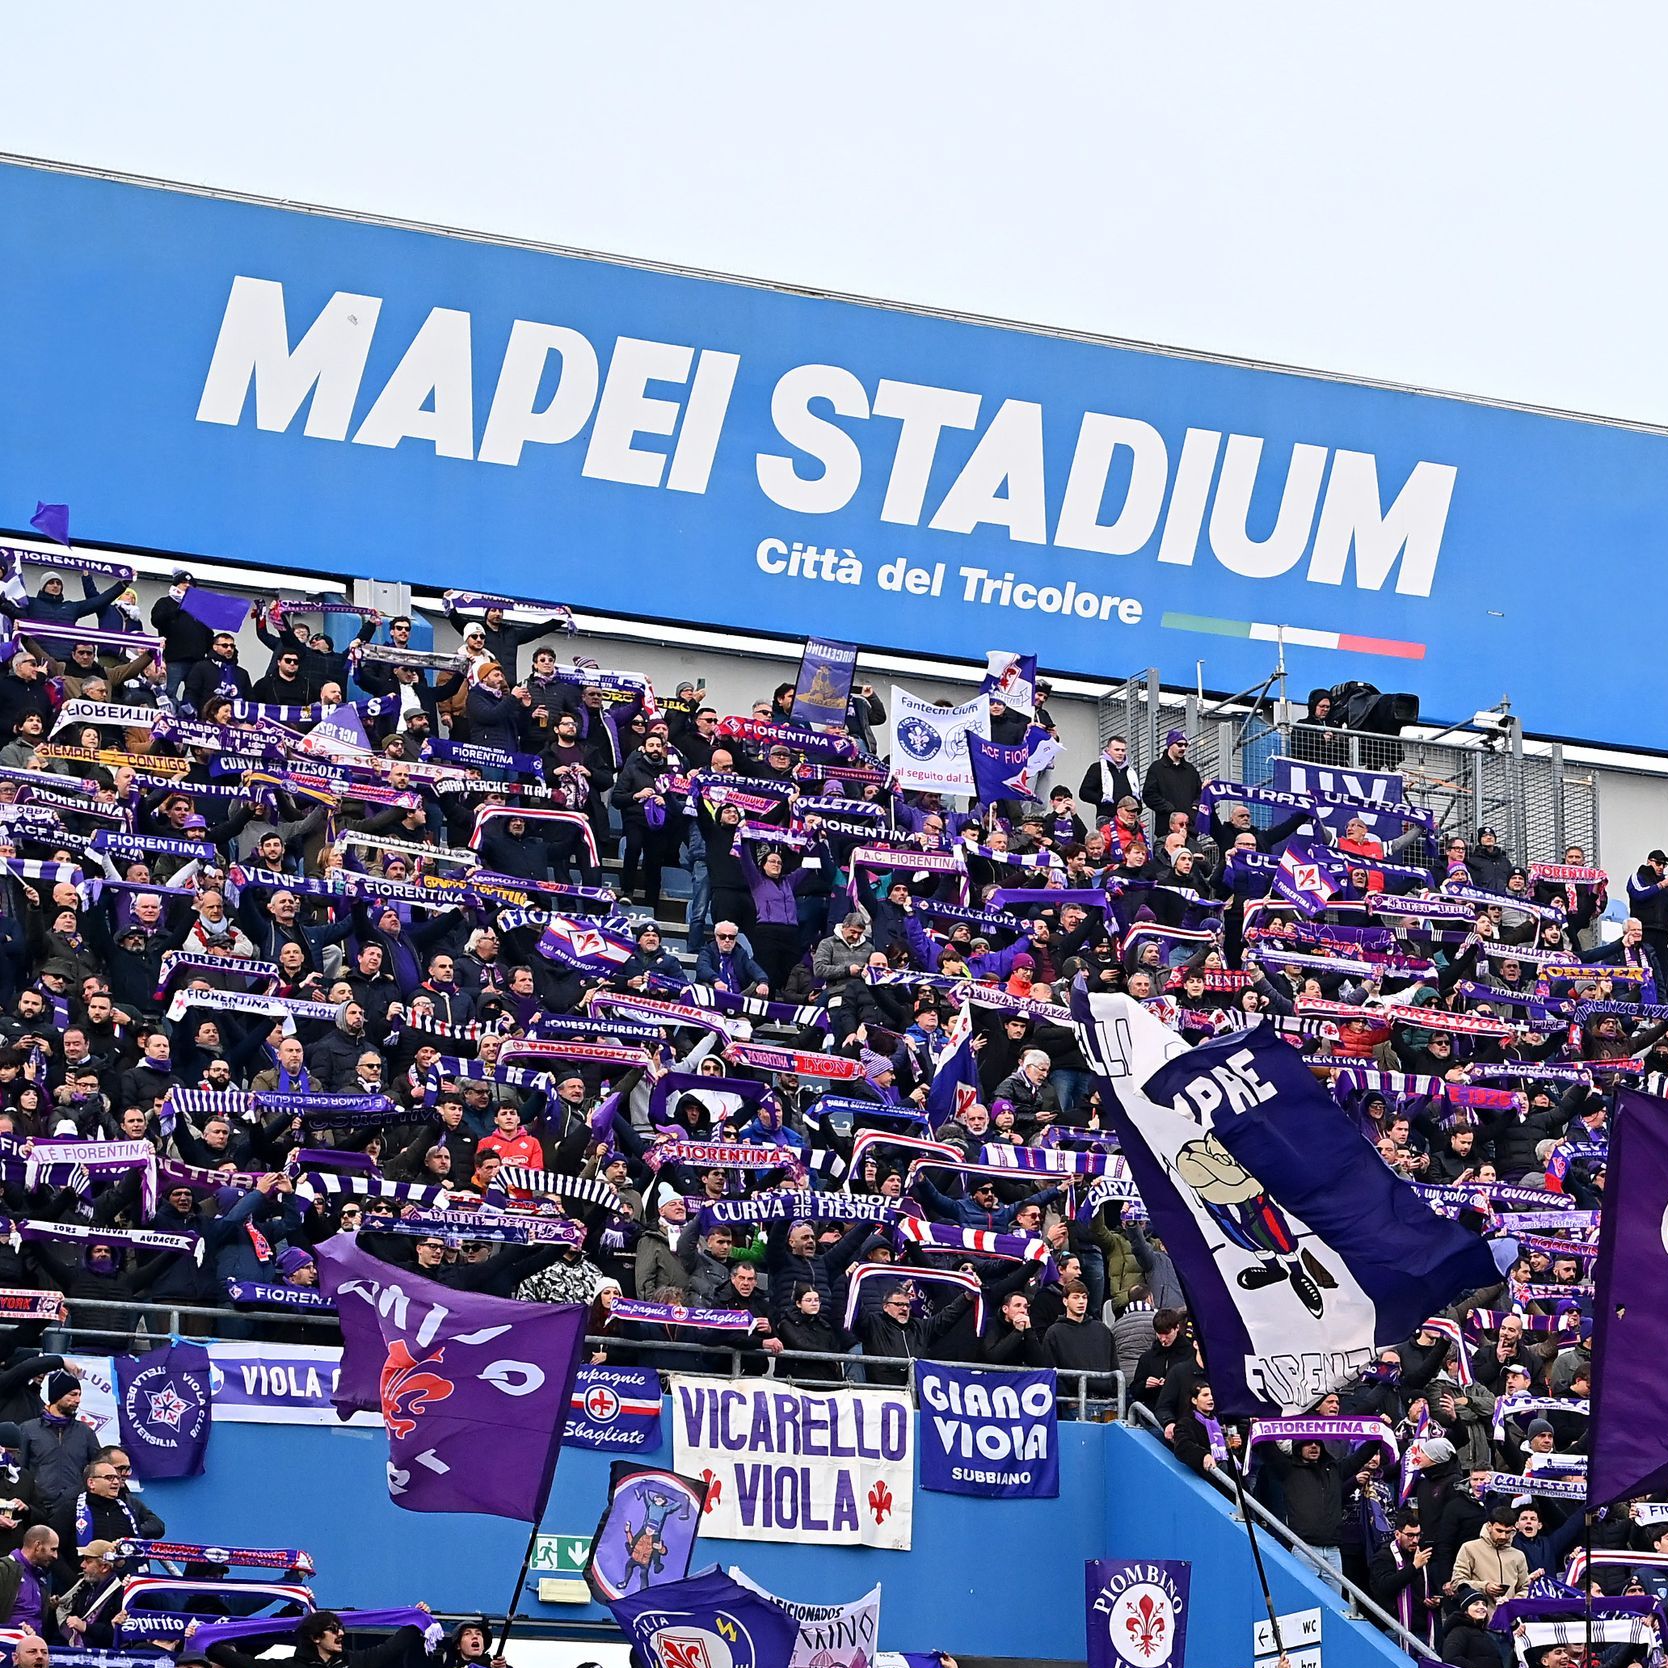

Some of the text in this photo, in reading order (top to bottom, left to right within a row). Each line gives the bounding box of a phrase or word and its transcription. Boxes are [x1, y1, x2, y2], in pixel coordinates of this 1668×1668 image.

[196, 275, 1459, 599] MAPEI STADIUM
[14, 549, 114, 574] FIORENTINA
[756, 535, 1144, 626] Città del Tricolore
[902, 697, 947, 711] Fantechi
[181, 721, 220, 736] BABBO
[229, 730, 240, 739] IN
[242, 731, 277, 744] FIGLIO
[220, 757, 345, 779] CURVA FIESOLE
[907, 769, 943, 782] seguito
[946, 772, 961, 782] dal
[136, 774, 251, 797] FIORENTINA
[1208, 778, 1316, 812] ULTRAS
[32, 788, 124, 817] FIORENTINA
[107, 834, 205, 856] FIORENTINA
[365, 883, 465, 903] FIORENTINA
[803, 1058, 848, 1075] LYON
[713, 1199, 785, 1222] CURVA
[241, 1365, 322, 1397] VIOLA
[183, 1372, 206, 1438] VIOLA CLUB
[923, 1374, 1053, 1417] GIANO
[132, 1420, 178, 1447] VERSILIA
[679, 1386, 907, 1462] VICARELLO
[938, 1424, 1049, 1461] VIOLA
[952, 1467, 1031, 1485] SUBBIANO
[734, 1462, 860, 1531] VIOLA
[1093, 1565, 1183, 1615] PIOMBINO
[638, 1614, 670, 1638] ALTA
[1303, 1620, 1316, 1634] WC
